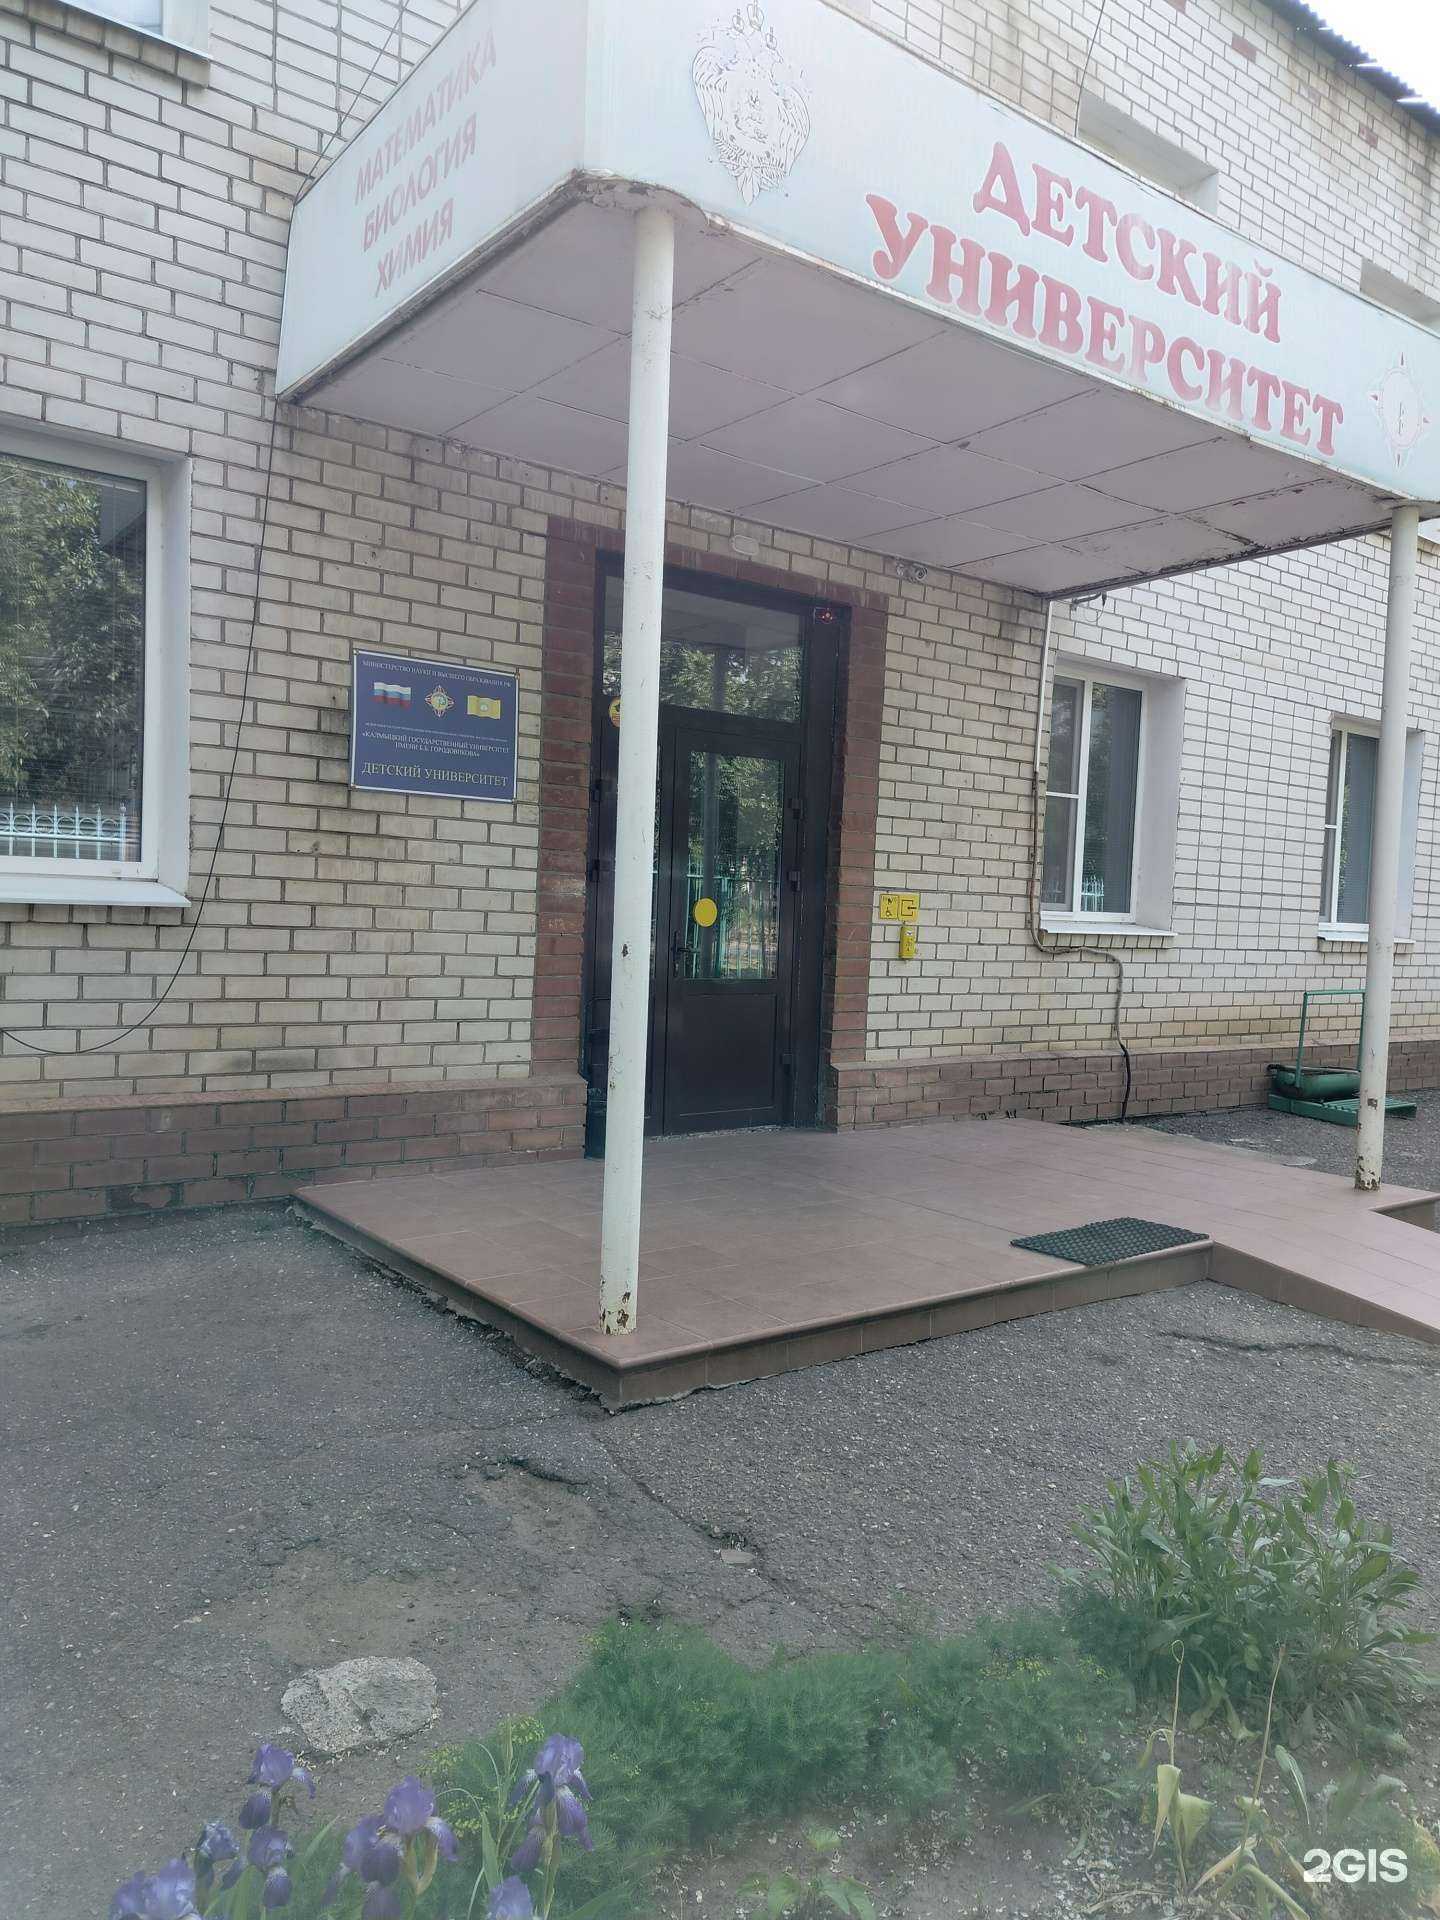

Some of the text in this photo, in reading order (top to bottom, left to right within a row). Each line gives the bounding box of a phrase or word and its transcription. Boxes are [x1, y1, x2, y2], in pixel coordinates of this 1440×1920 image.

[354, 27, 498, 206] МАТЕМАТИКА
[363, 112, 477, 252] БИОЛОГИЯ
[375, 197, 454, 298] ХИМИЯ
[972, 140, 1283, 343] ДЕТСКИЙ
[864, 192, 1344, 457] УНИВЕРСИТЕТ
[361, 762, 509, 787] ДЕТСКИЙ УНИВЕРСИТЕТ
